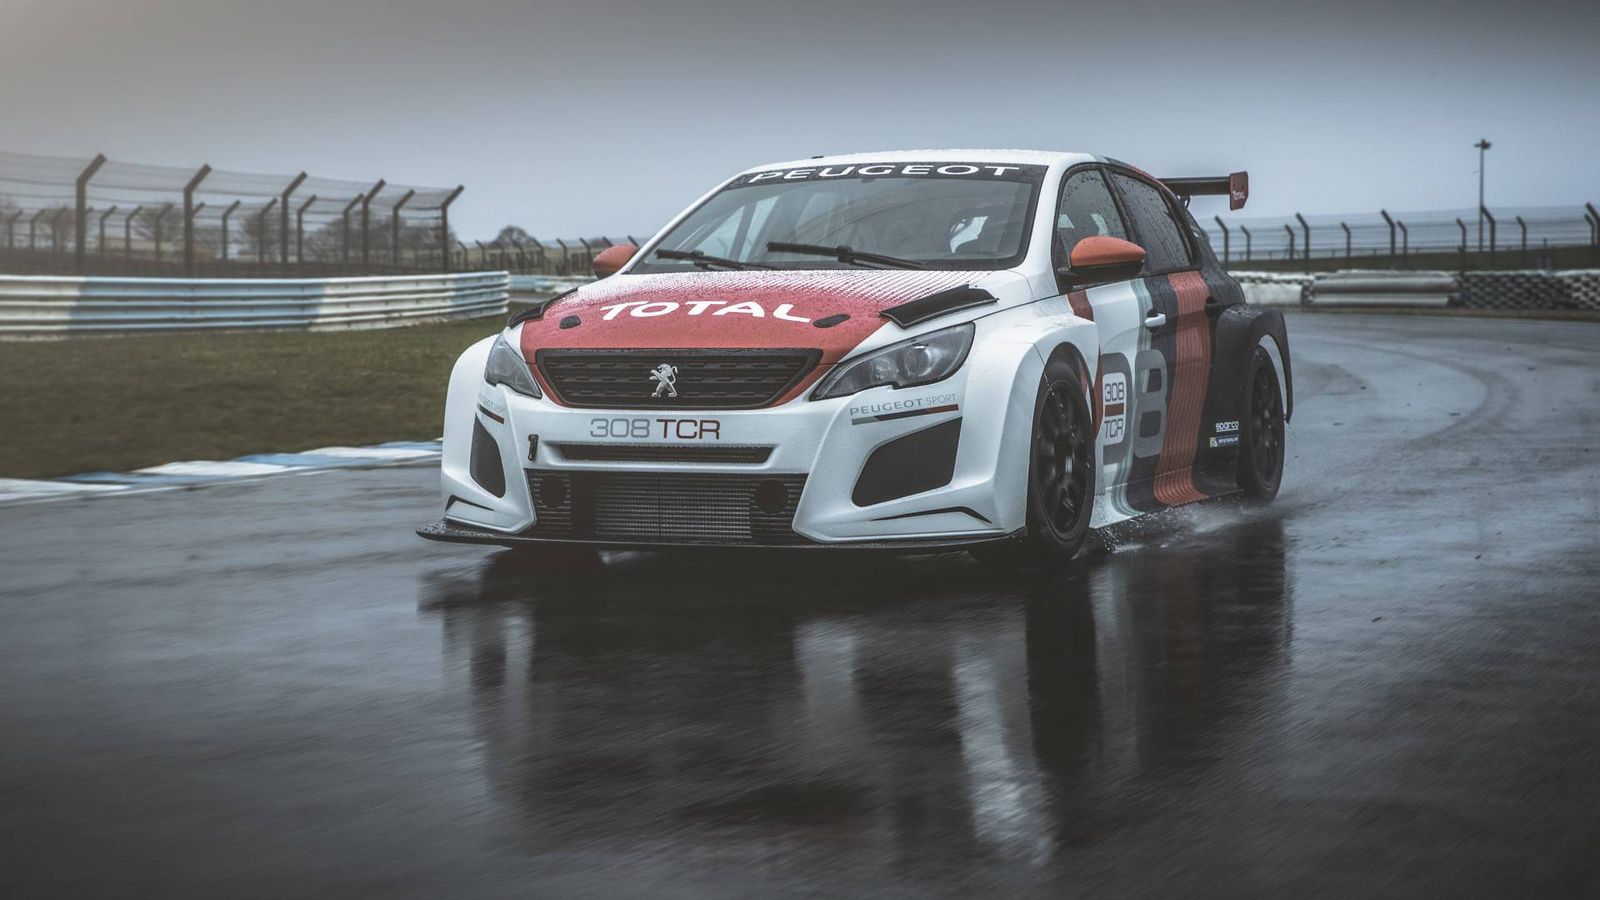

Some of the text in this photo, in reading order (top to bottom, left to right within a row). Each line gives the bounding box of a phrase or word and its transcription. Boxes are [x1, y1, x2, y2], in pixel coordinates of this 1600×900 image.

[749, 164, 1020, 183] PEUGEOT
[600, 300, 811, 323] TOTAL
[1104, 382, 1125, 402] 308
[849, 393, 957, 416] PEUGEOT SPORT
[590, 418, 721, 440] 308 TCR
[1104, 418, 1124, 439] TCR
[1215, 421, 1240, 432] sparco
